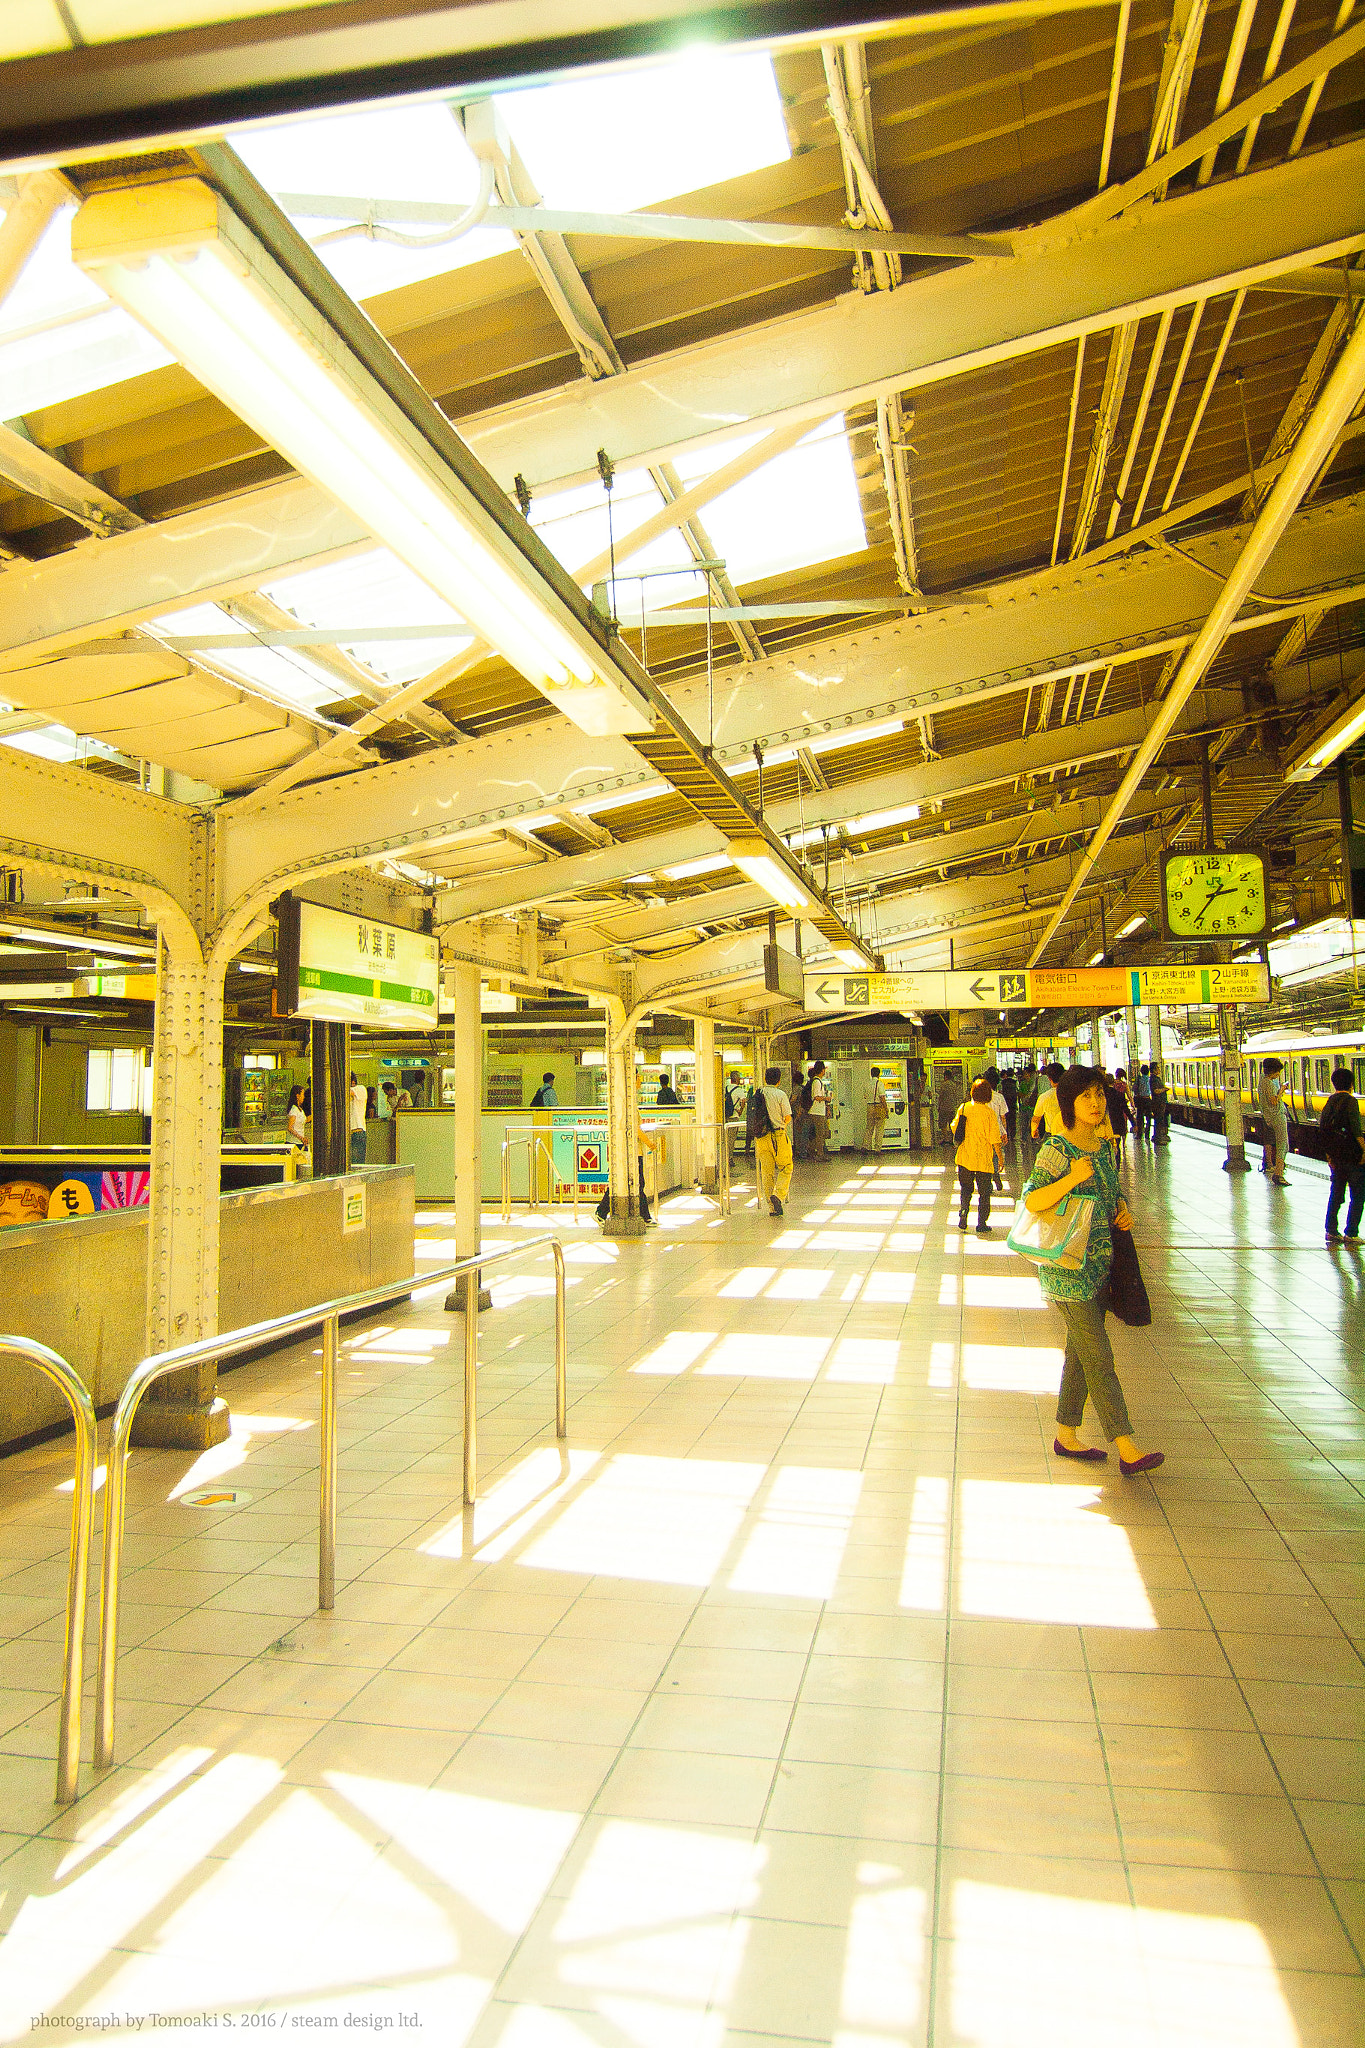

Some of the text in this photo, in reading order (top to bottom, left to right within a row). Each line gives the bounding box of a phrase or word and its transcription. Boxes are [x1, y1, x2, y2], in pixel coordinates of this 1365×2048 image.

[1206, 861, 1220, 869] 12
[1194, 866, 1204, 874] 11
[1206, 877, 1221, 885] JR
[1240, 873, 1248, 881] 2
[1174, 891, 1183, 900] 9
[1247, 889, 1255, 898] 3
[1182, 908, 1190, 916] 8
[1241, 906, 1249, 915] 4
[1198, 917, 1204, 926] 7
[1212, 920, 1220, 929] 6
[1227, 916, 1236, 925] 5
[358, 924, 396, 960] 秋葉原
[1151, 970, 1196, 979] 京浜東北線
[1211, 969, 1222, 985] 2
[1222, 968, 1249, 978] 山手線
[1035, 973, 1077, 984] 電気街口
[1142, 971, 1148, 986] 1
[871, 986, 920, 994] エスカレーター
[1143, 987, 1186, 995] 上野・大宮方面
[1213, 986, 1257, 994] 上野・池袋方面
[62, 1188, 80, 1215] も
